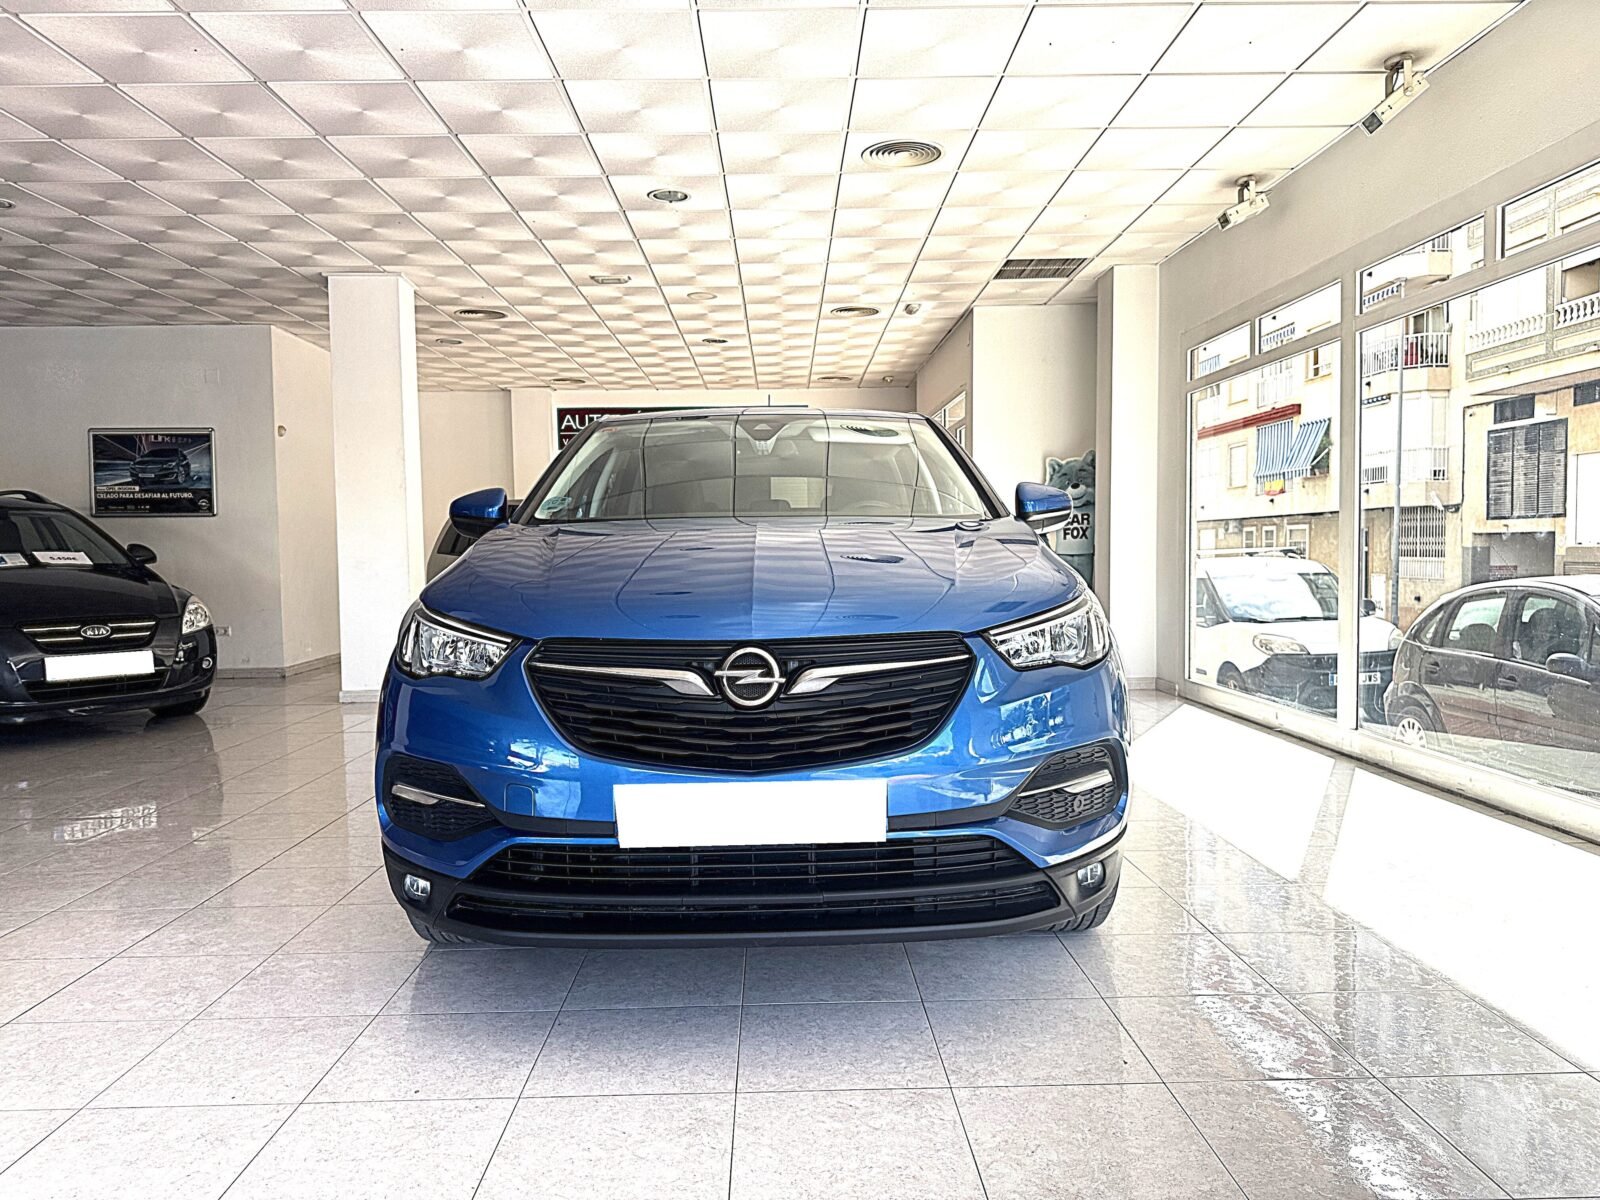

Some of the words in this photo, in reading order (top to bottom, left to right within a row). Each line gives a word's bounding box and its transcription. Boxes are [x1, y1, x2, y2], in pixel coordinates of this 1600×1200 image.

[1065, 512, 1090, 526] AR
[1063, 526, 1089, 541] FOX
[86, 627, 107, 636] KIA
